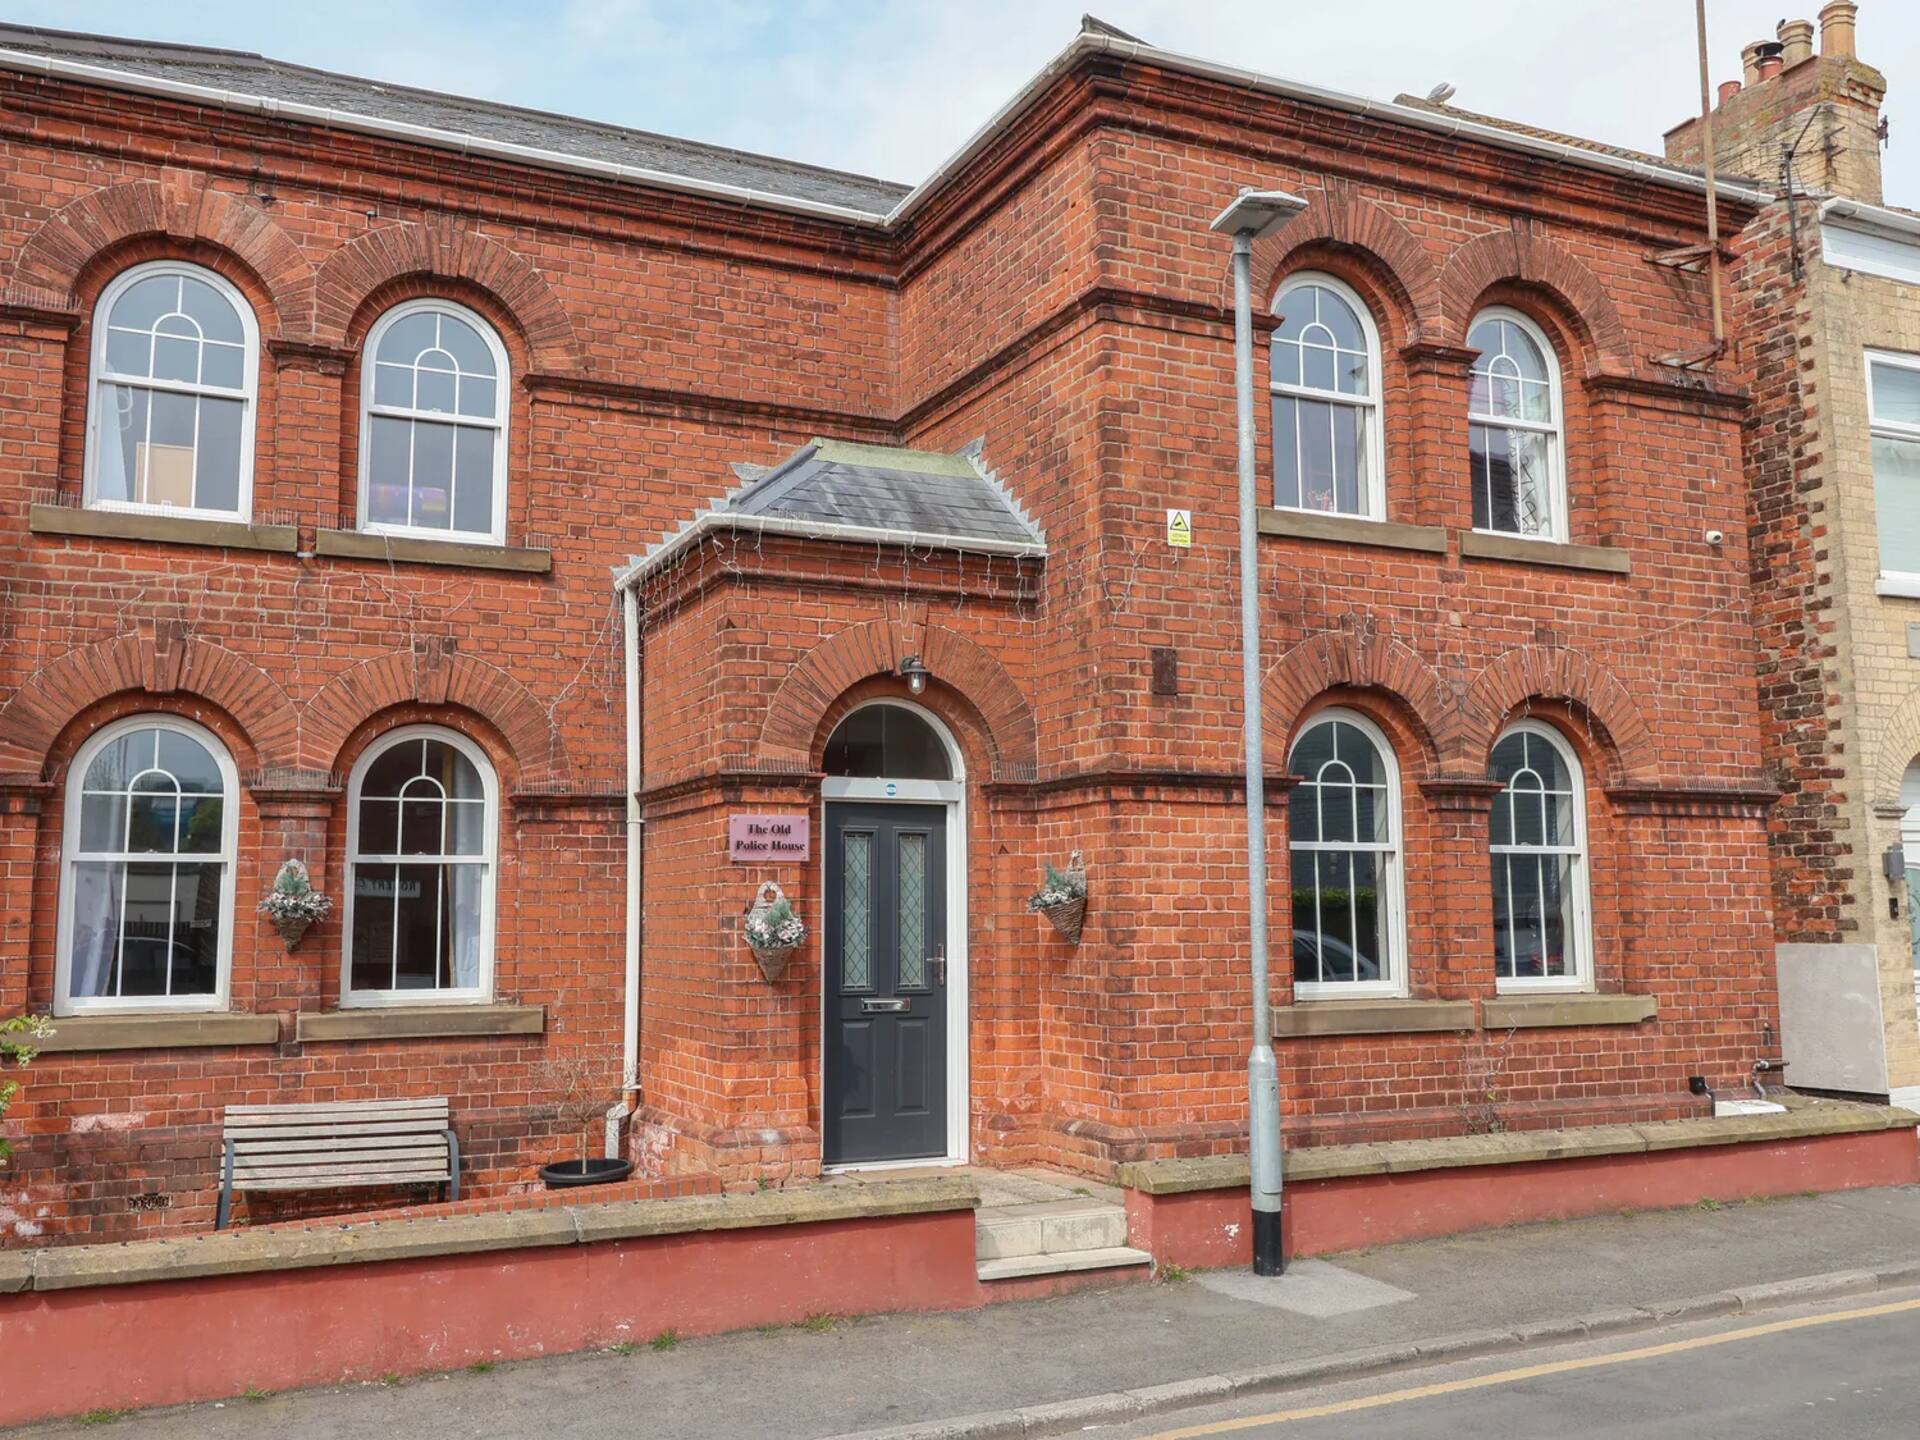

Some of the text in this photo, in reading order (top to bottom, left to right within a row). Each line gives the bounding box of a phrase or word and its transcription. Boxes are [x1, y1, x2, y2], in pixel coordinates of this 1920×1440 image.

[747, 823, 791, 834] The Old
[736, 840, 805, 850] Police House
